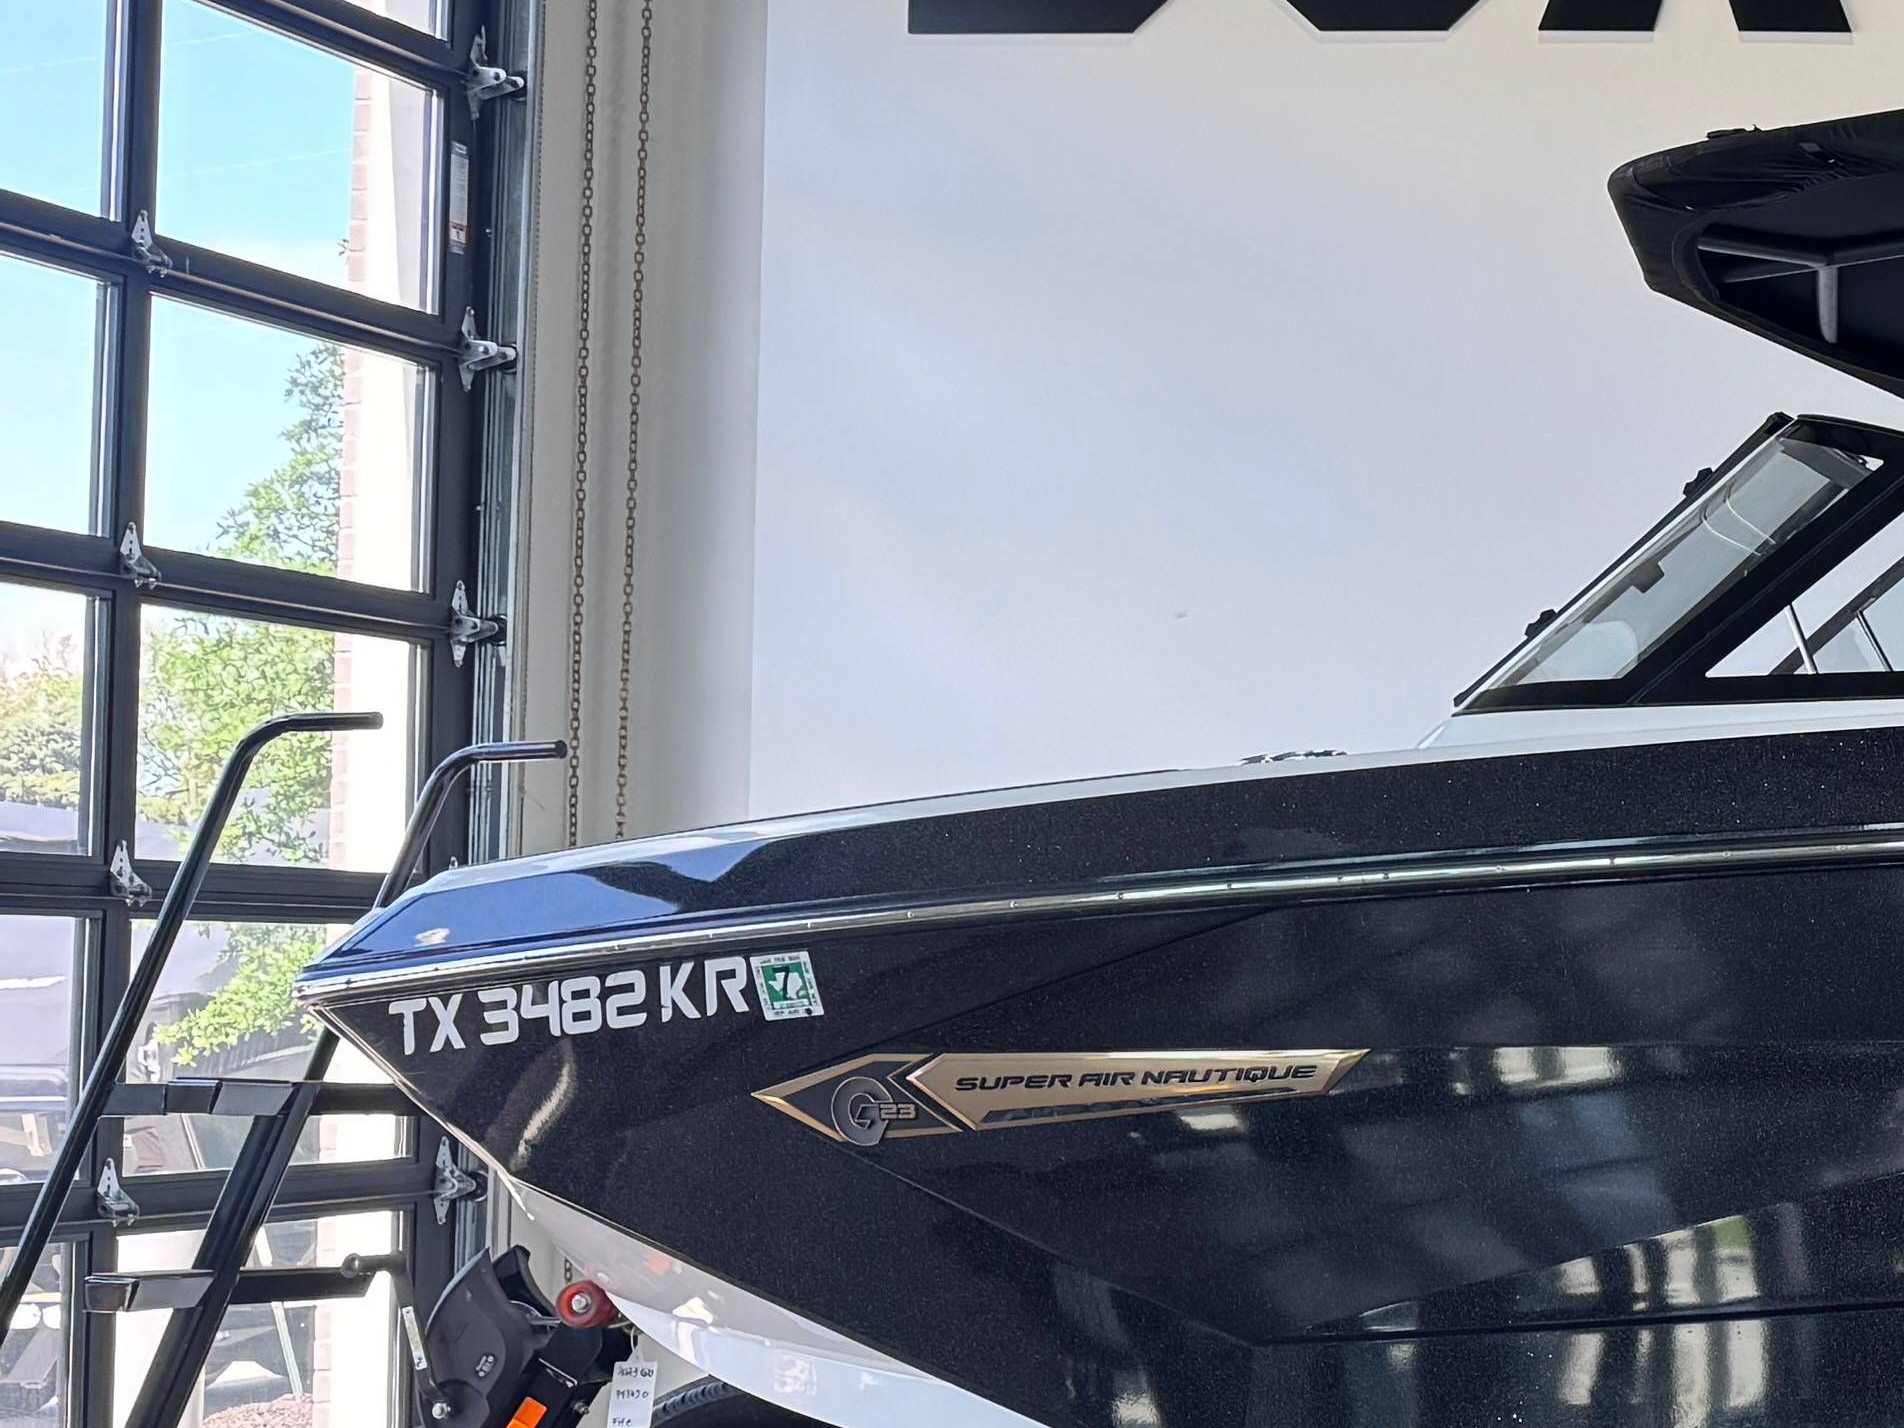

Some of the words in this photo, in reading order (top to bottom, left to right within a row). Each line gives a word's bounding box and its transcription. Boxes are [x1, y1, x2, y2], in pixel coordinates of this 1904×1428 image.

[388, 992, 468, 1057] TX
[478, 969, 649, 1047] 3482
[659, 955, 751, 1024] KR
[954, 1073, 1072, 1092] SUPER
[1077, 1071, 1135, 1088] AIR
[1140, 1064, 1319, 1086] NAUTIQUE
